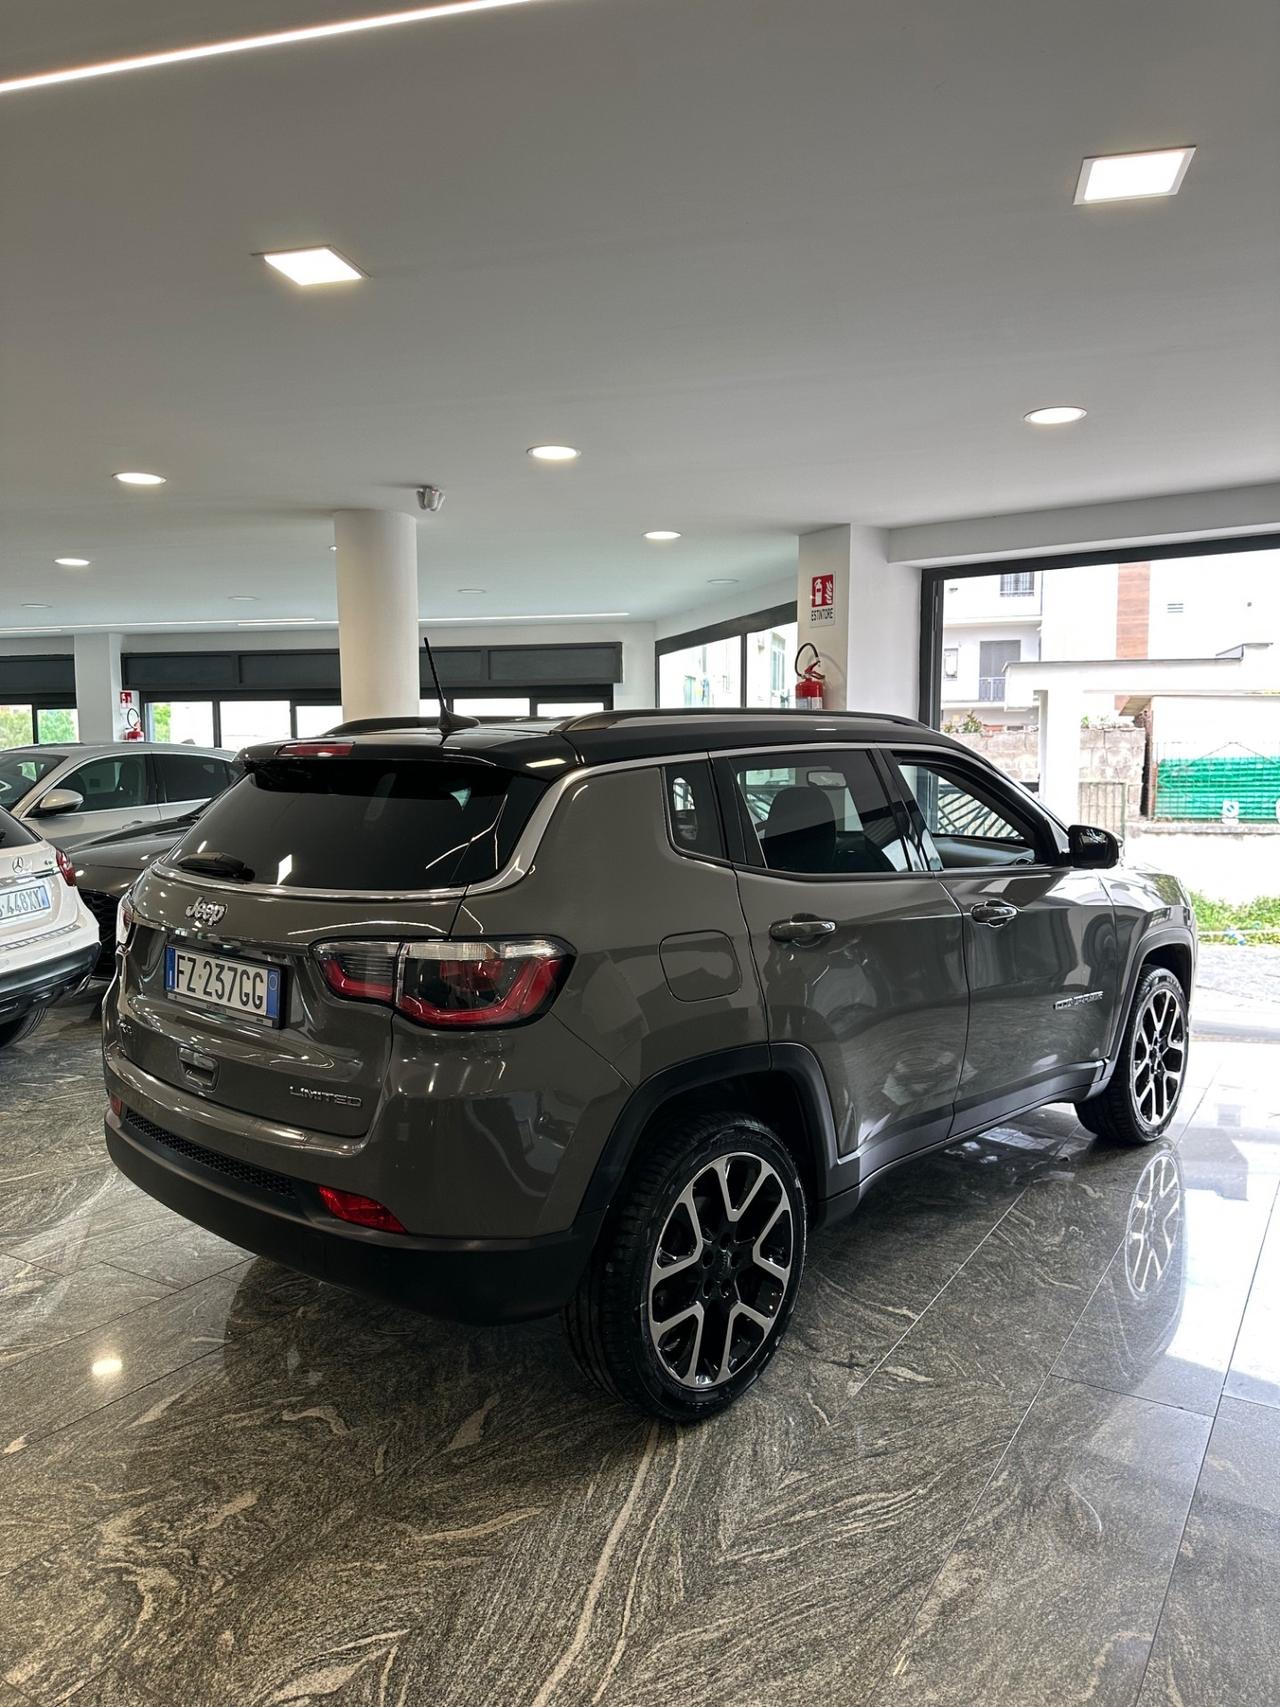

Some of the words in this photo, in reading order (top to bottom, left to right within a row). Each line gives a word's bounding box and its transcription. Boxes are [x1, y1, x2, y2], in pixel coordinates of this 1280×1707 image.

[811, 608, 833, 621] ESTINTORE
[185, 896, 225, 926] Jeep
[289, 1085, 362, 1107] LIMITED
